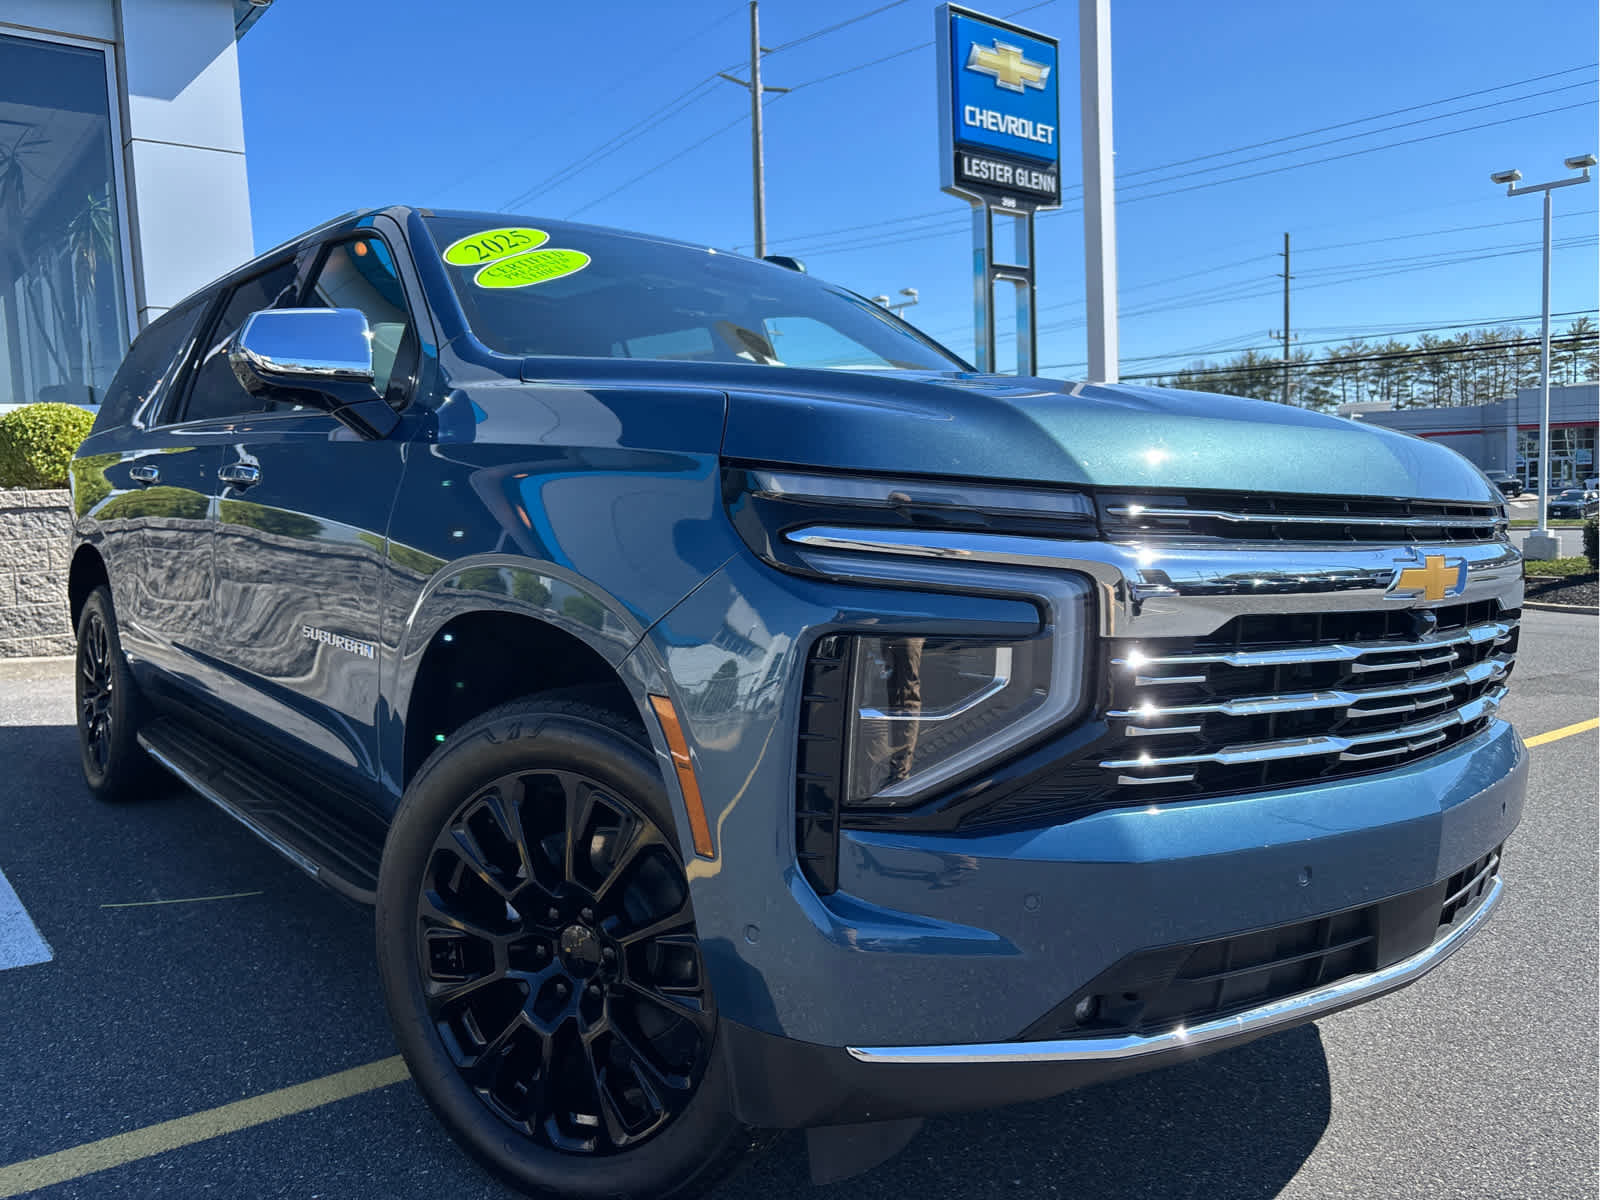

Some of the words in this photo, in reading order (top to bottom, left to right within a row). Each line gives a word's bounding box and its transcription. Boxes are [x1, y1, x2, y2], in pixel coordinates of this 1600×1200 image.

[965, 106, 1054, 144] CHEVROLET
[963, 157, 1013, 184] LESTER
[1015, 169, 1056, 193] GLENN
[464, 230, 531, 260] 2025
[487, 252, 566, 277] CERTIFIED
[302, 626, 374, 659] SUBURBAN
